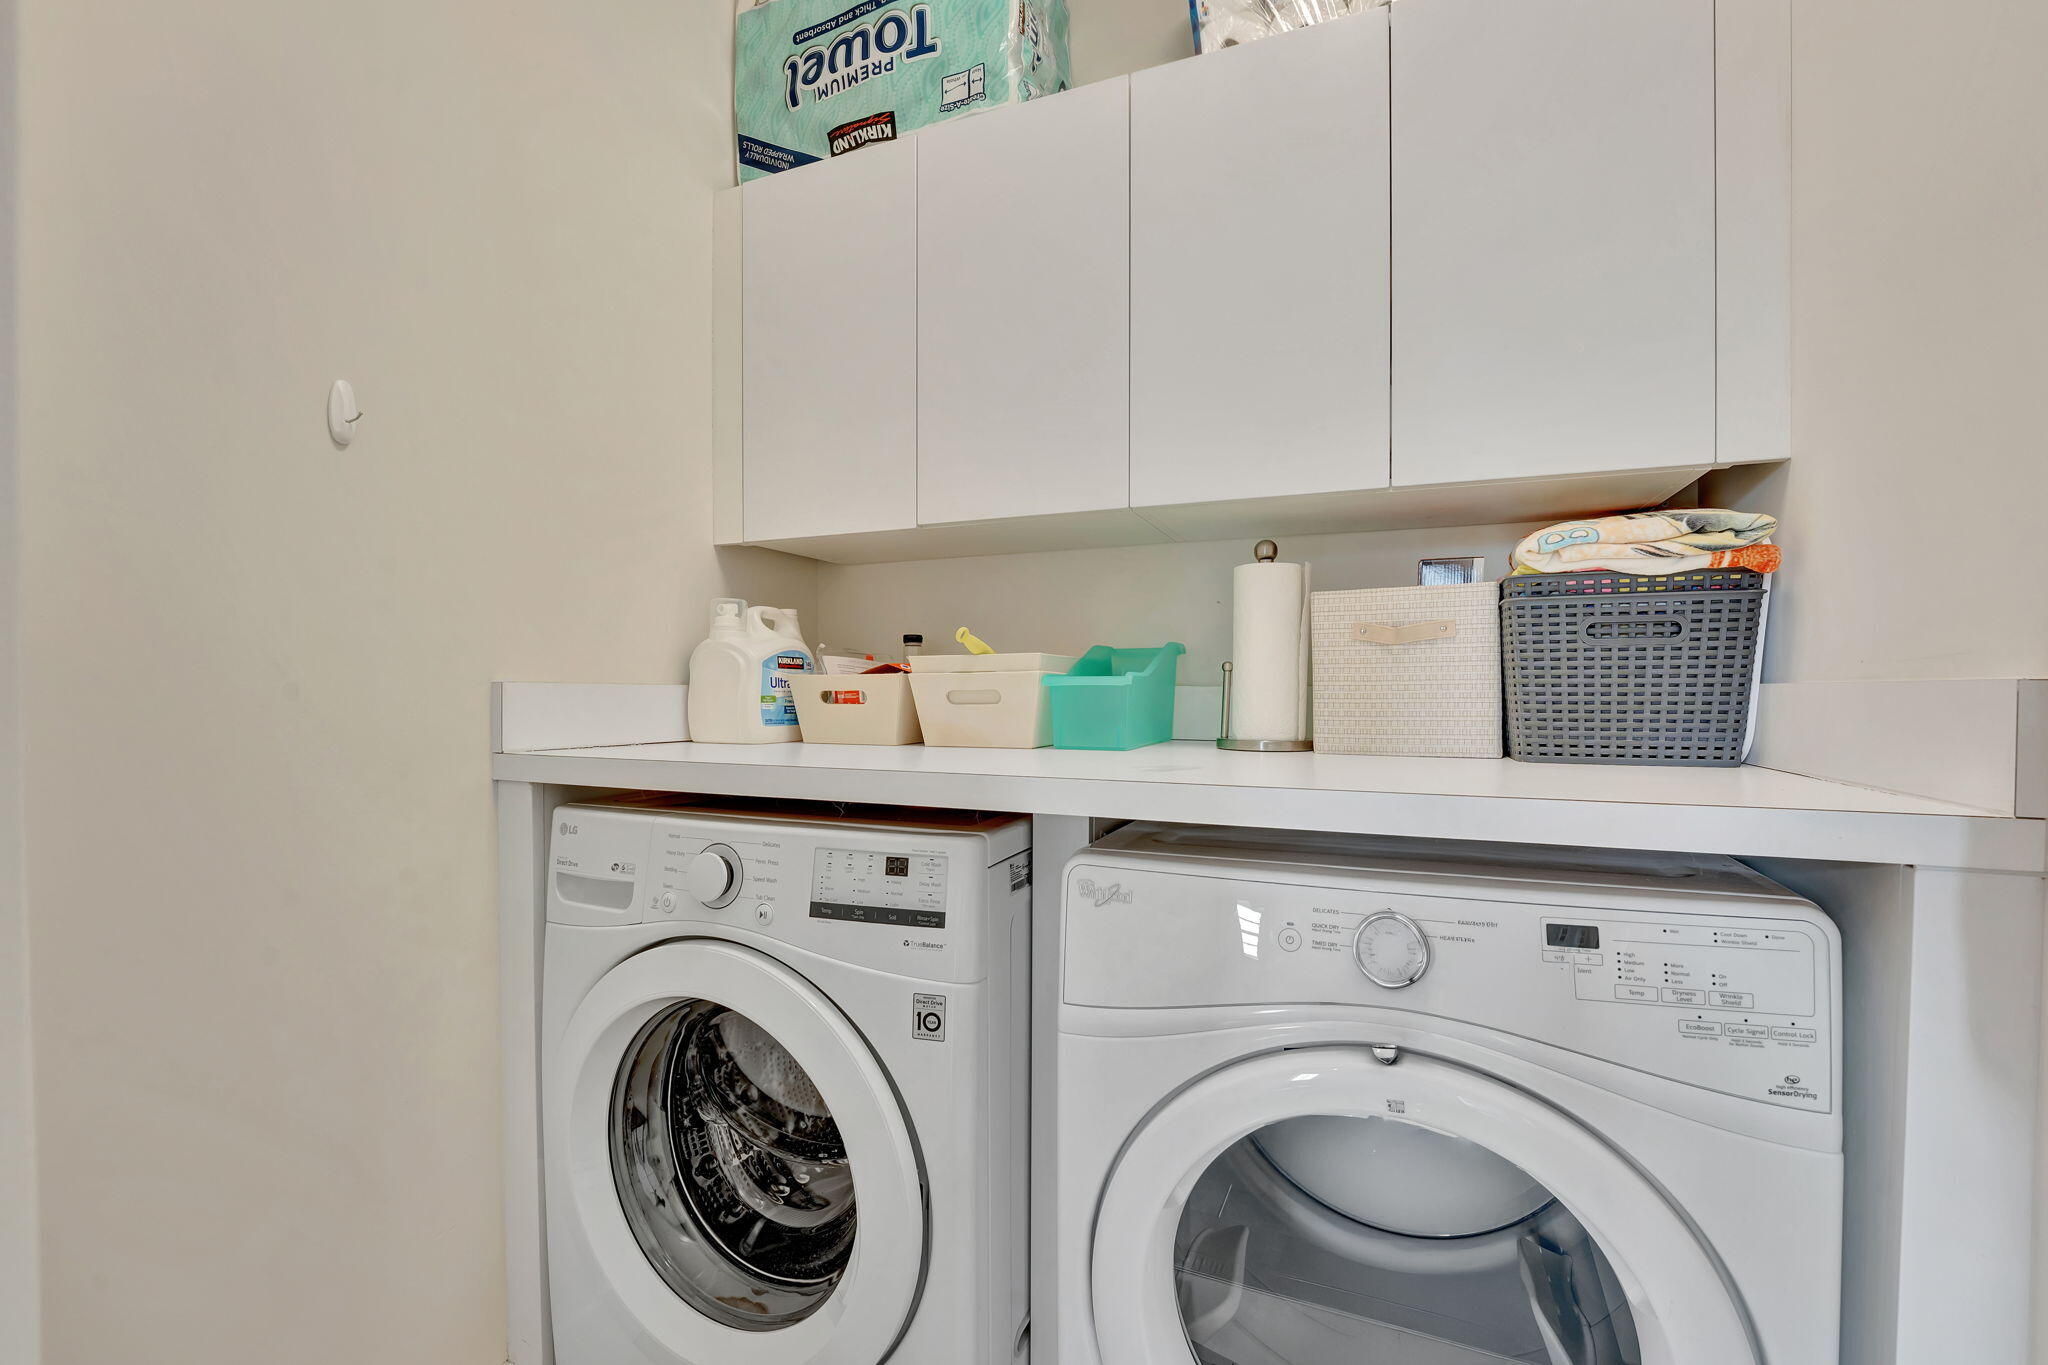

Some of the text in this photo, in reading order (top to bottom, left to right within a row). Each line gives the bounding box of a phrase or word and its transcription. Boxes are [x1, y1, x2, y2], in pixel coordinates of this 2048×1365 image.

[796, 2, 877, 42] Thick and Absorbent
[788, 8, 939, 109] Towel
[816, 57, 894, 102] PREMIUM
[830, 112, 891, 137] Signature
[832, 123, 893, 154] KIRKLAND
[743, 141, 795, 163] ROLLS WRAPPED
[745, 151, 790, 170] INDIVIDUALLY
[779, 657, 803, 665] KIRKLAND
[569, 825, 578, 835] LG
[1312, 907, 1340, 915] DELICATES
[1629, 989, 1645, 998] Temp
[1672, 989, 1697, 998] Dryness
[917, 1012, 942, 1032] 10
[1686, 1023, 1715, 1032] EcoBoost
[1727, 1026, 1766, 1036] Cycle Signal
[1773, 1029, 1814, 1040] Control Lock
[1768, 1088, 1818, 1100] SensorDrying
